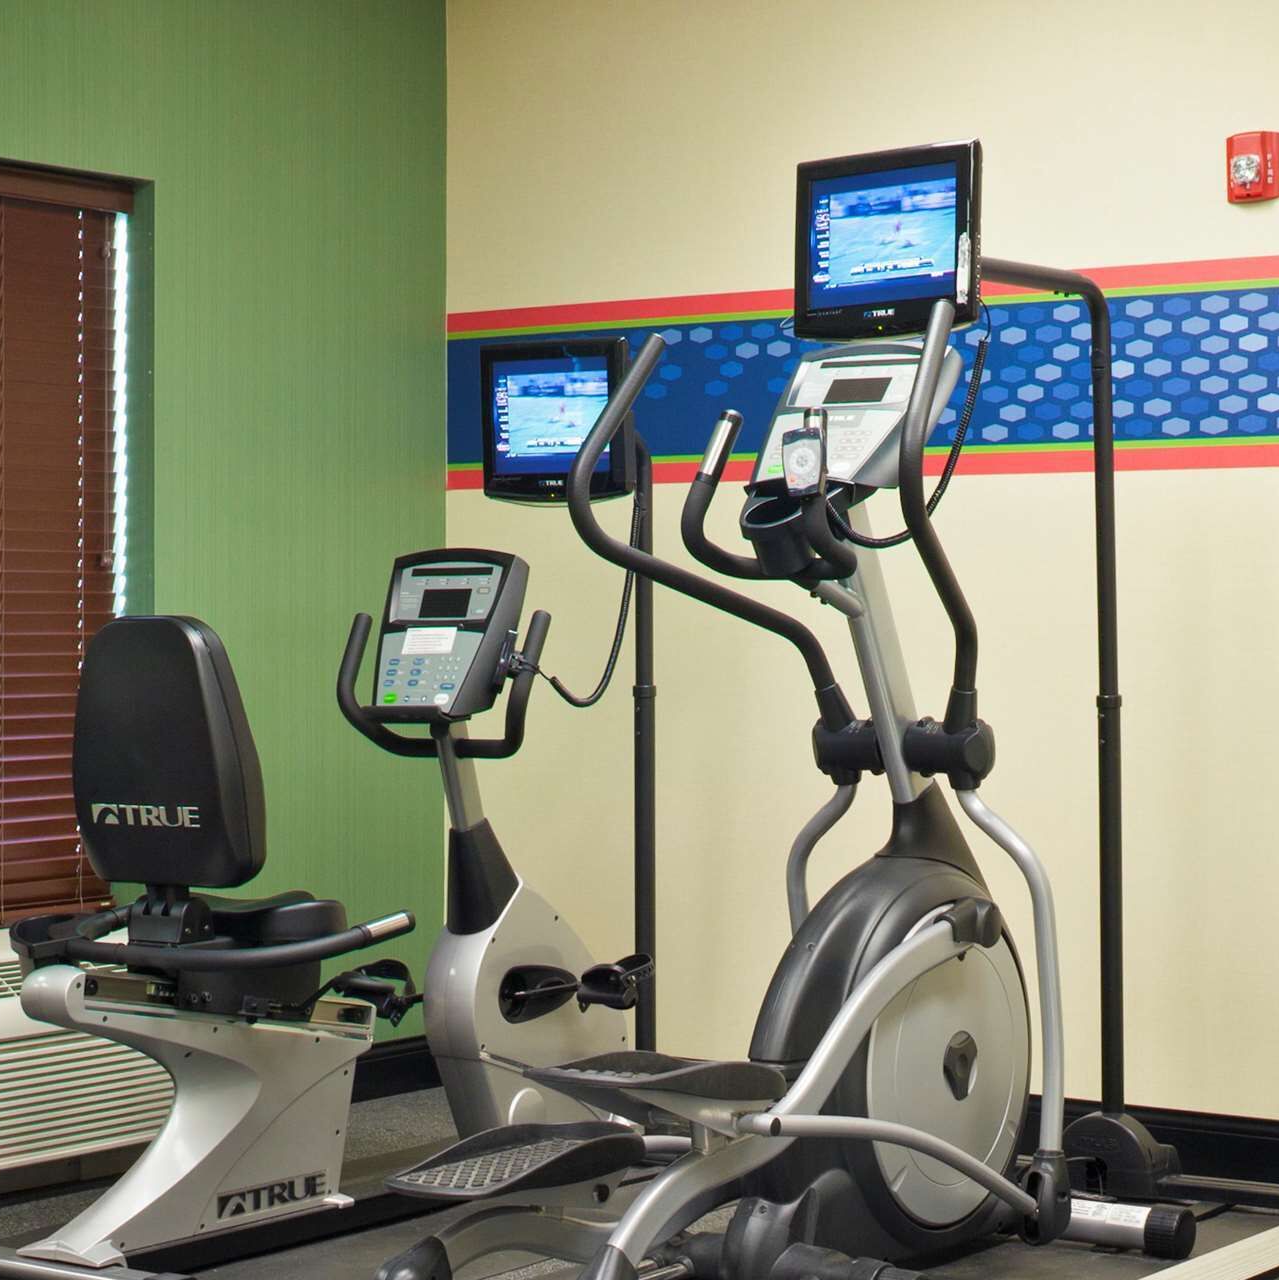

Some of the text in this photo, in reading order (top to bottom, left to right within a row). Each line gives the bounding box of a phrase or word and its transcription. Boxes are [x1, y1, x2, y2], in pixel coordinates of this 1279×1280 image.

[870, 308, 896, 318] TRUE
[118, 804, 201, 828] TRUE
[246, 1172, 327, 1211] TRUE
